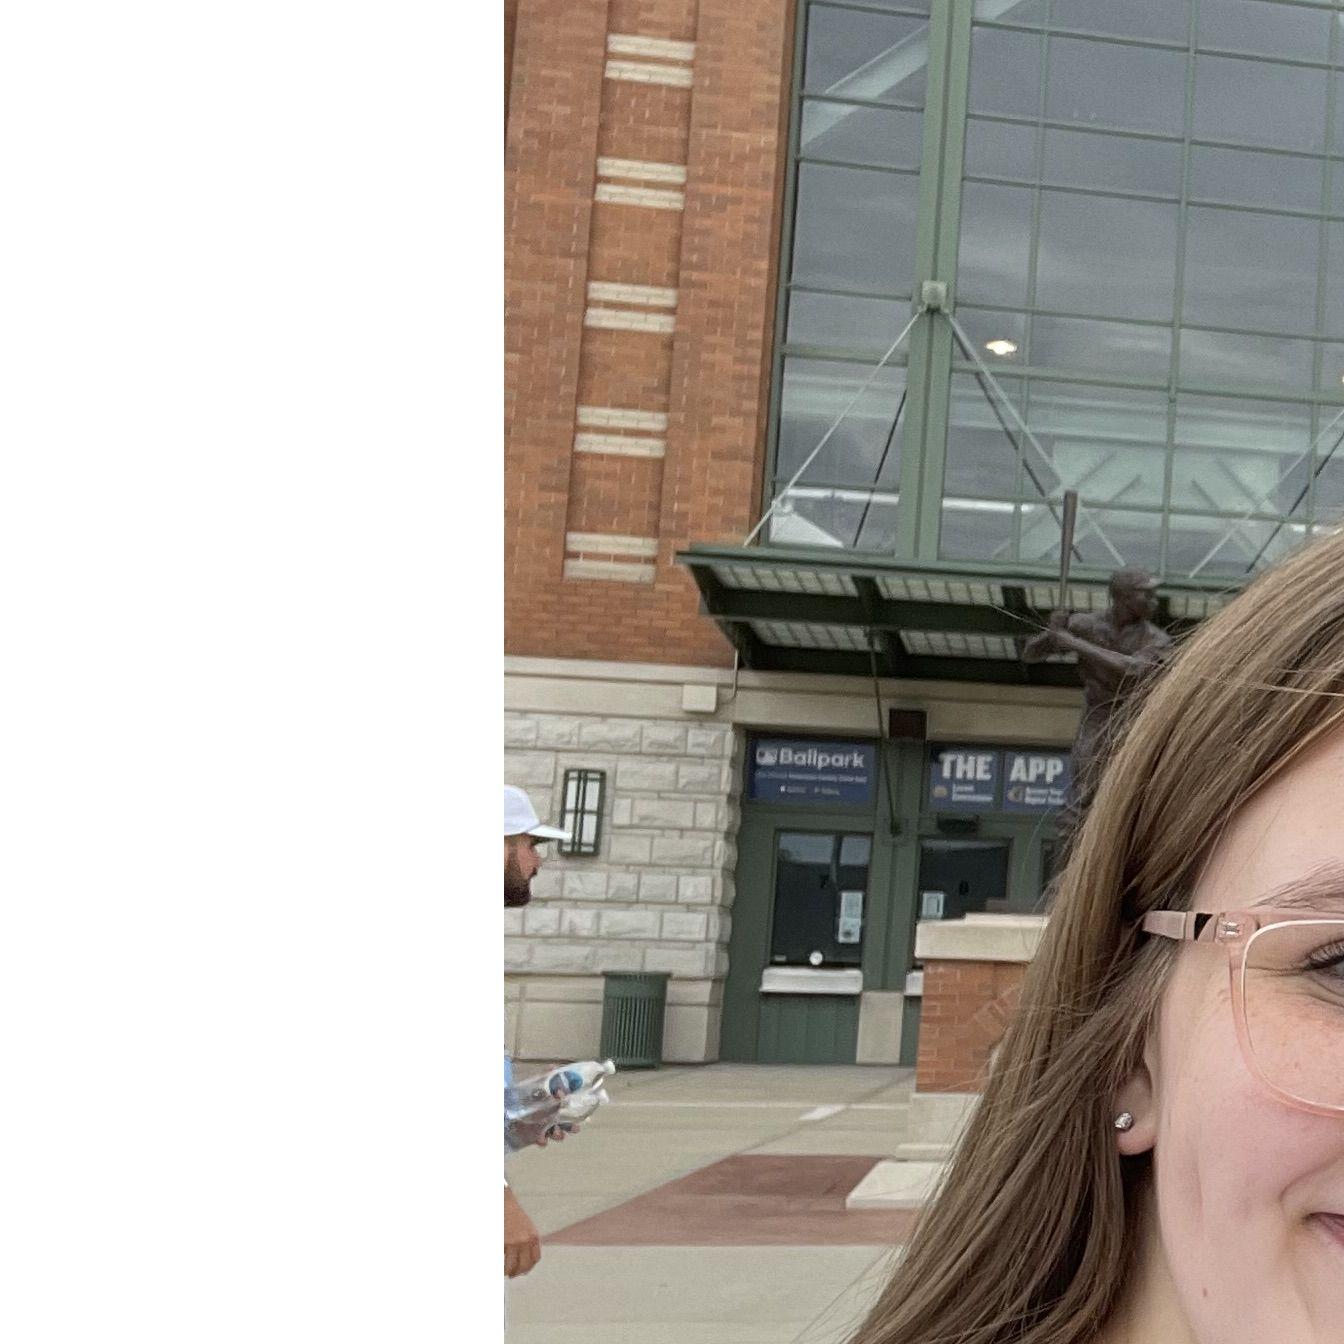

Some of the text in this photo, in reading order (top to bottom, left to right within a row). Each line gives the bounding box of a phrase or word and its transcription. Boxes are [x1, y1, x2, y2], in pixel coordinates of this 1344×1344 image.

[780, 746, 865, 771] Ballpark
[939, 752, 1064, 785] THE APP
